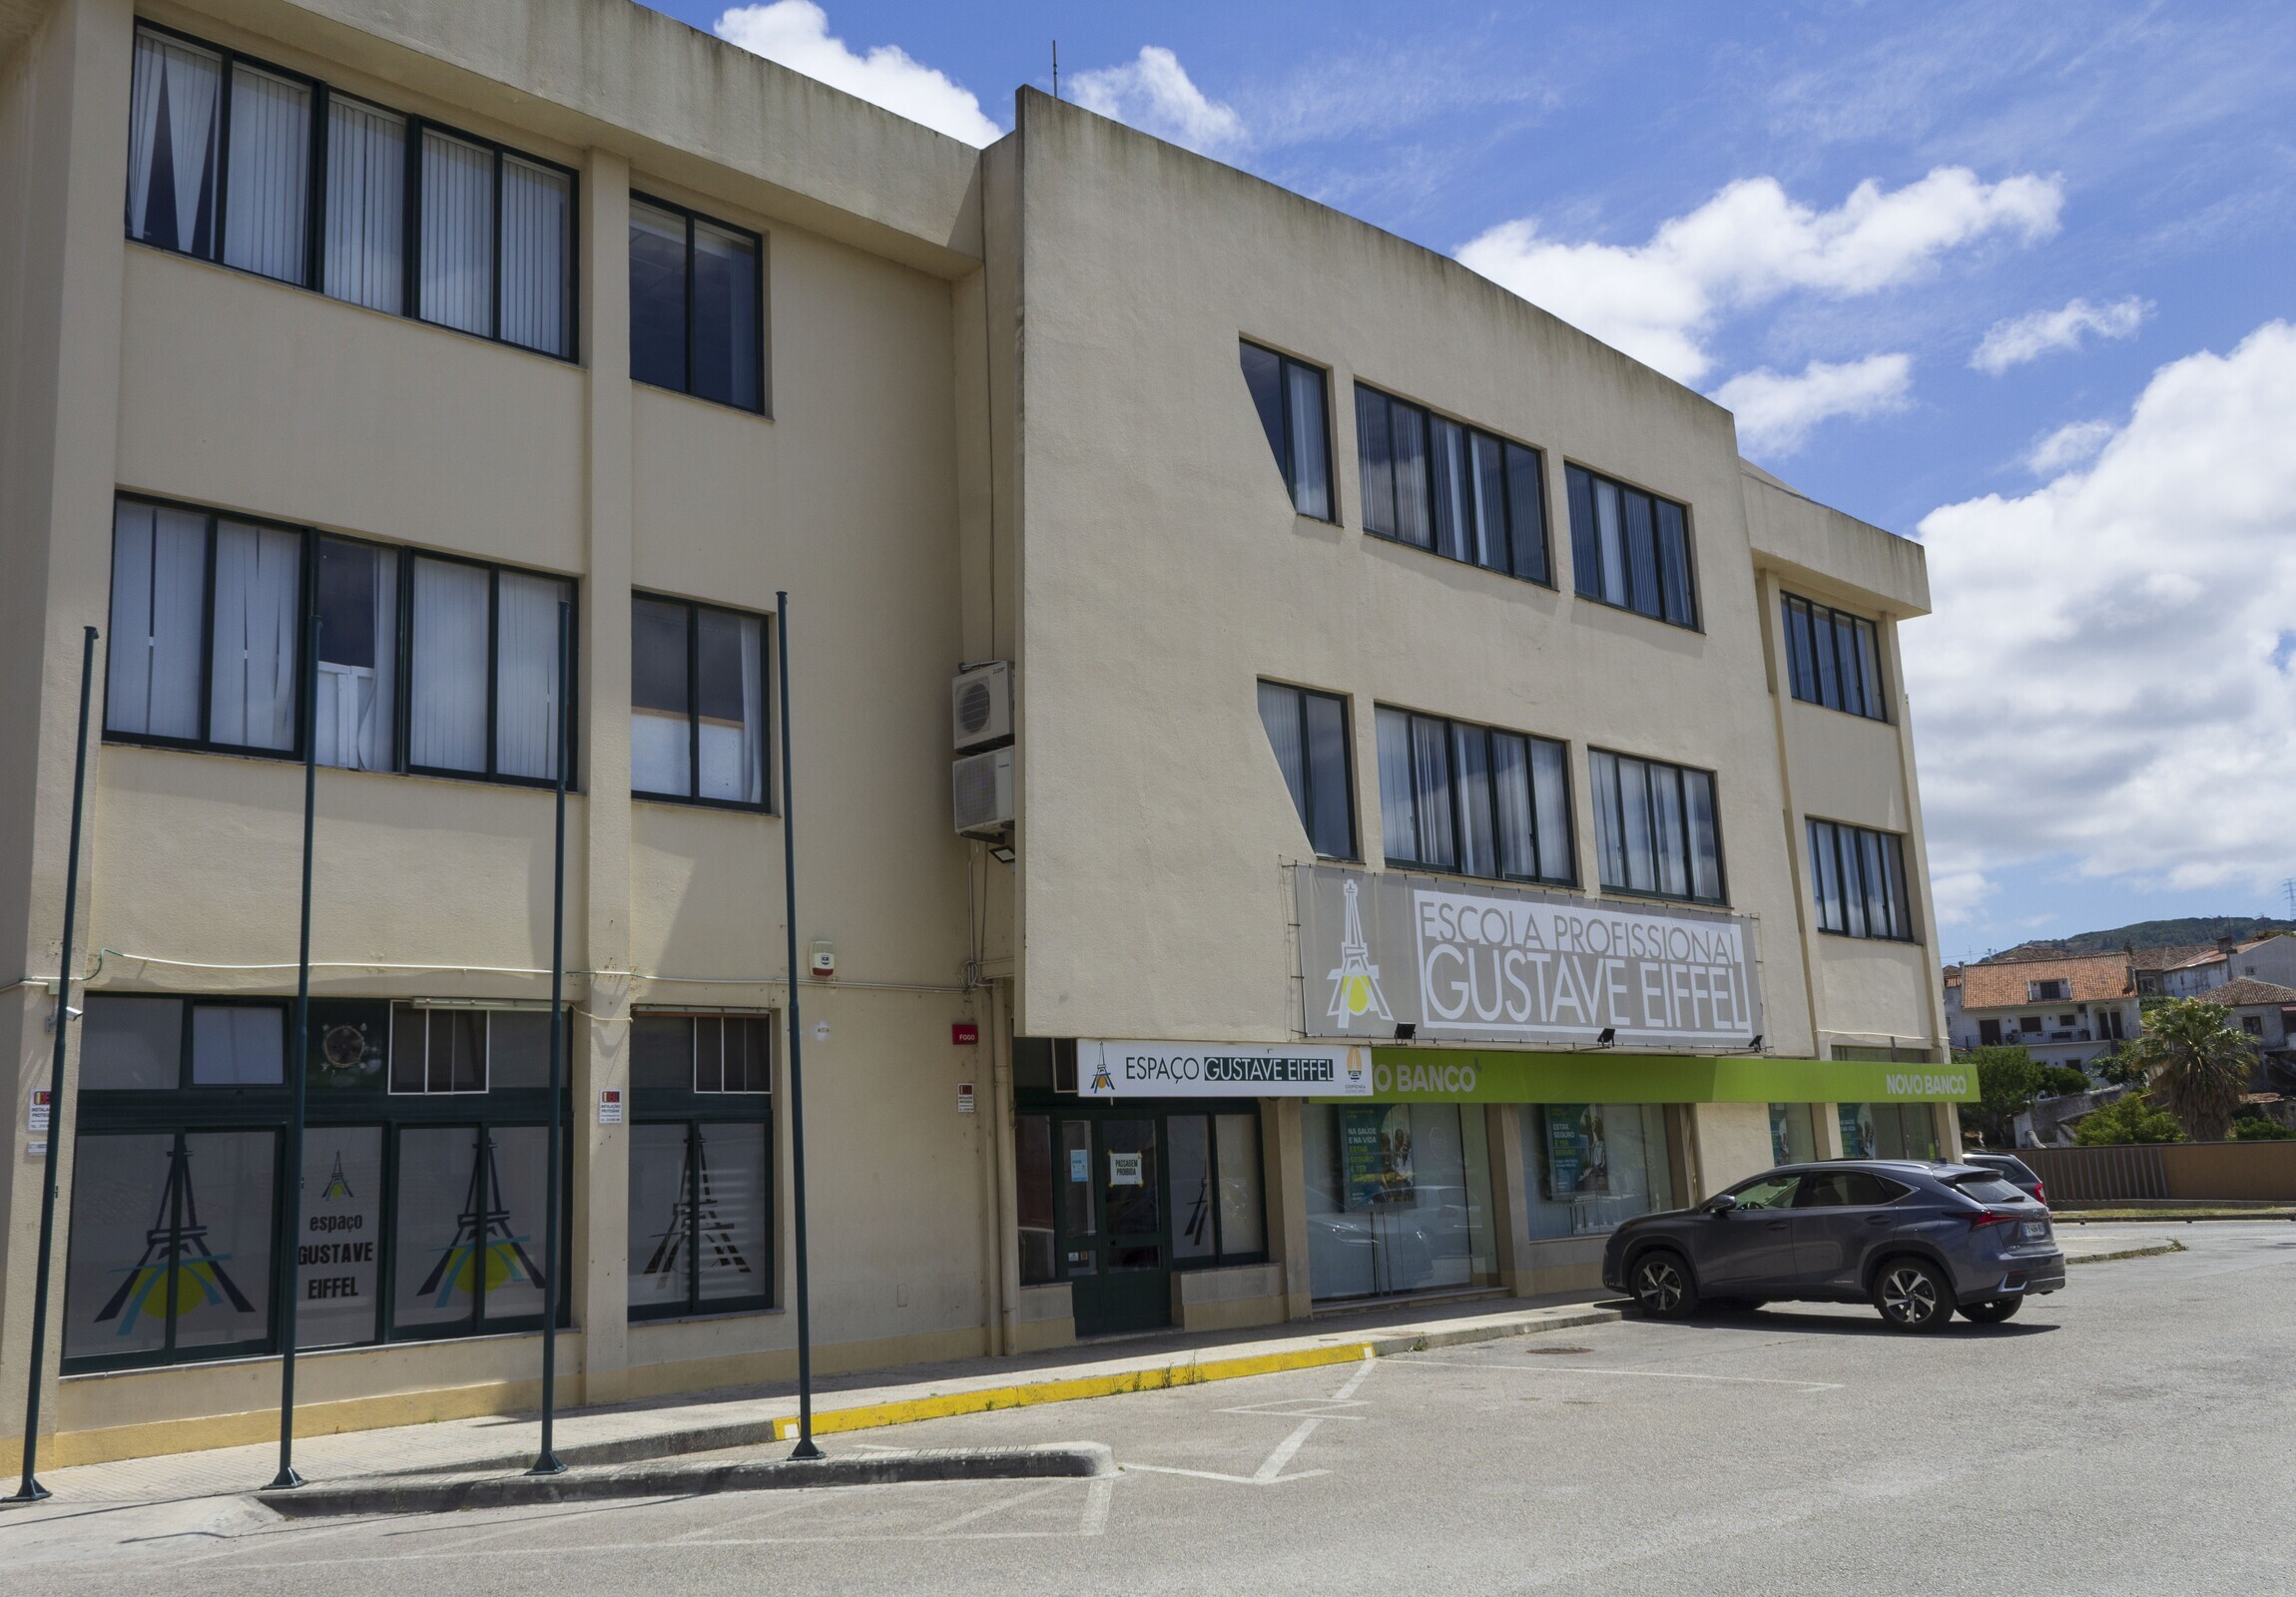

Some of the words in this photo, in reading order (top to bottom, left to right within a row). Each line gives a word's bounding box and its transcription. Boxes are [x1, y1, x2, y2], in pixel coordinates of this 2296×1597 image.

[1420, 901, 1545, 949] ESCOLA
[1554, 914, 1742, 965] PROFISSIONAL
[1426, 943, 1631, 1026] GUSTAVE
[1639, 961, 1748, 1030] EIFFEL
[1126, 1056, 1200, 1084] ESPAÇO
[1205, 1057, 1283, 1081] GUSTAVE
[1288, 1059, 1334, 1082] EIFFEL
[1397, 1064, 1476, 1093] BANCO
[1886, 1074, 1923, 1095] NOVO
[1925, 1075, 1967, 1095] BANCO
[1115, 1159, 1138, 1168] PASSAGEM
[309, 1215, 362, 1234] espaço
[298, 1242, 373, 1266] GUSTAVE
[307, 1277, 359, 1300] EIFFEL
